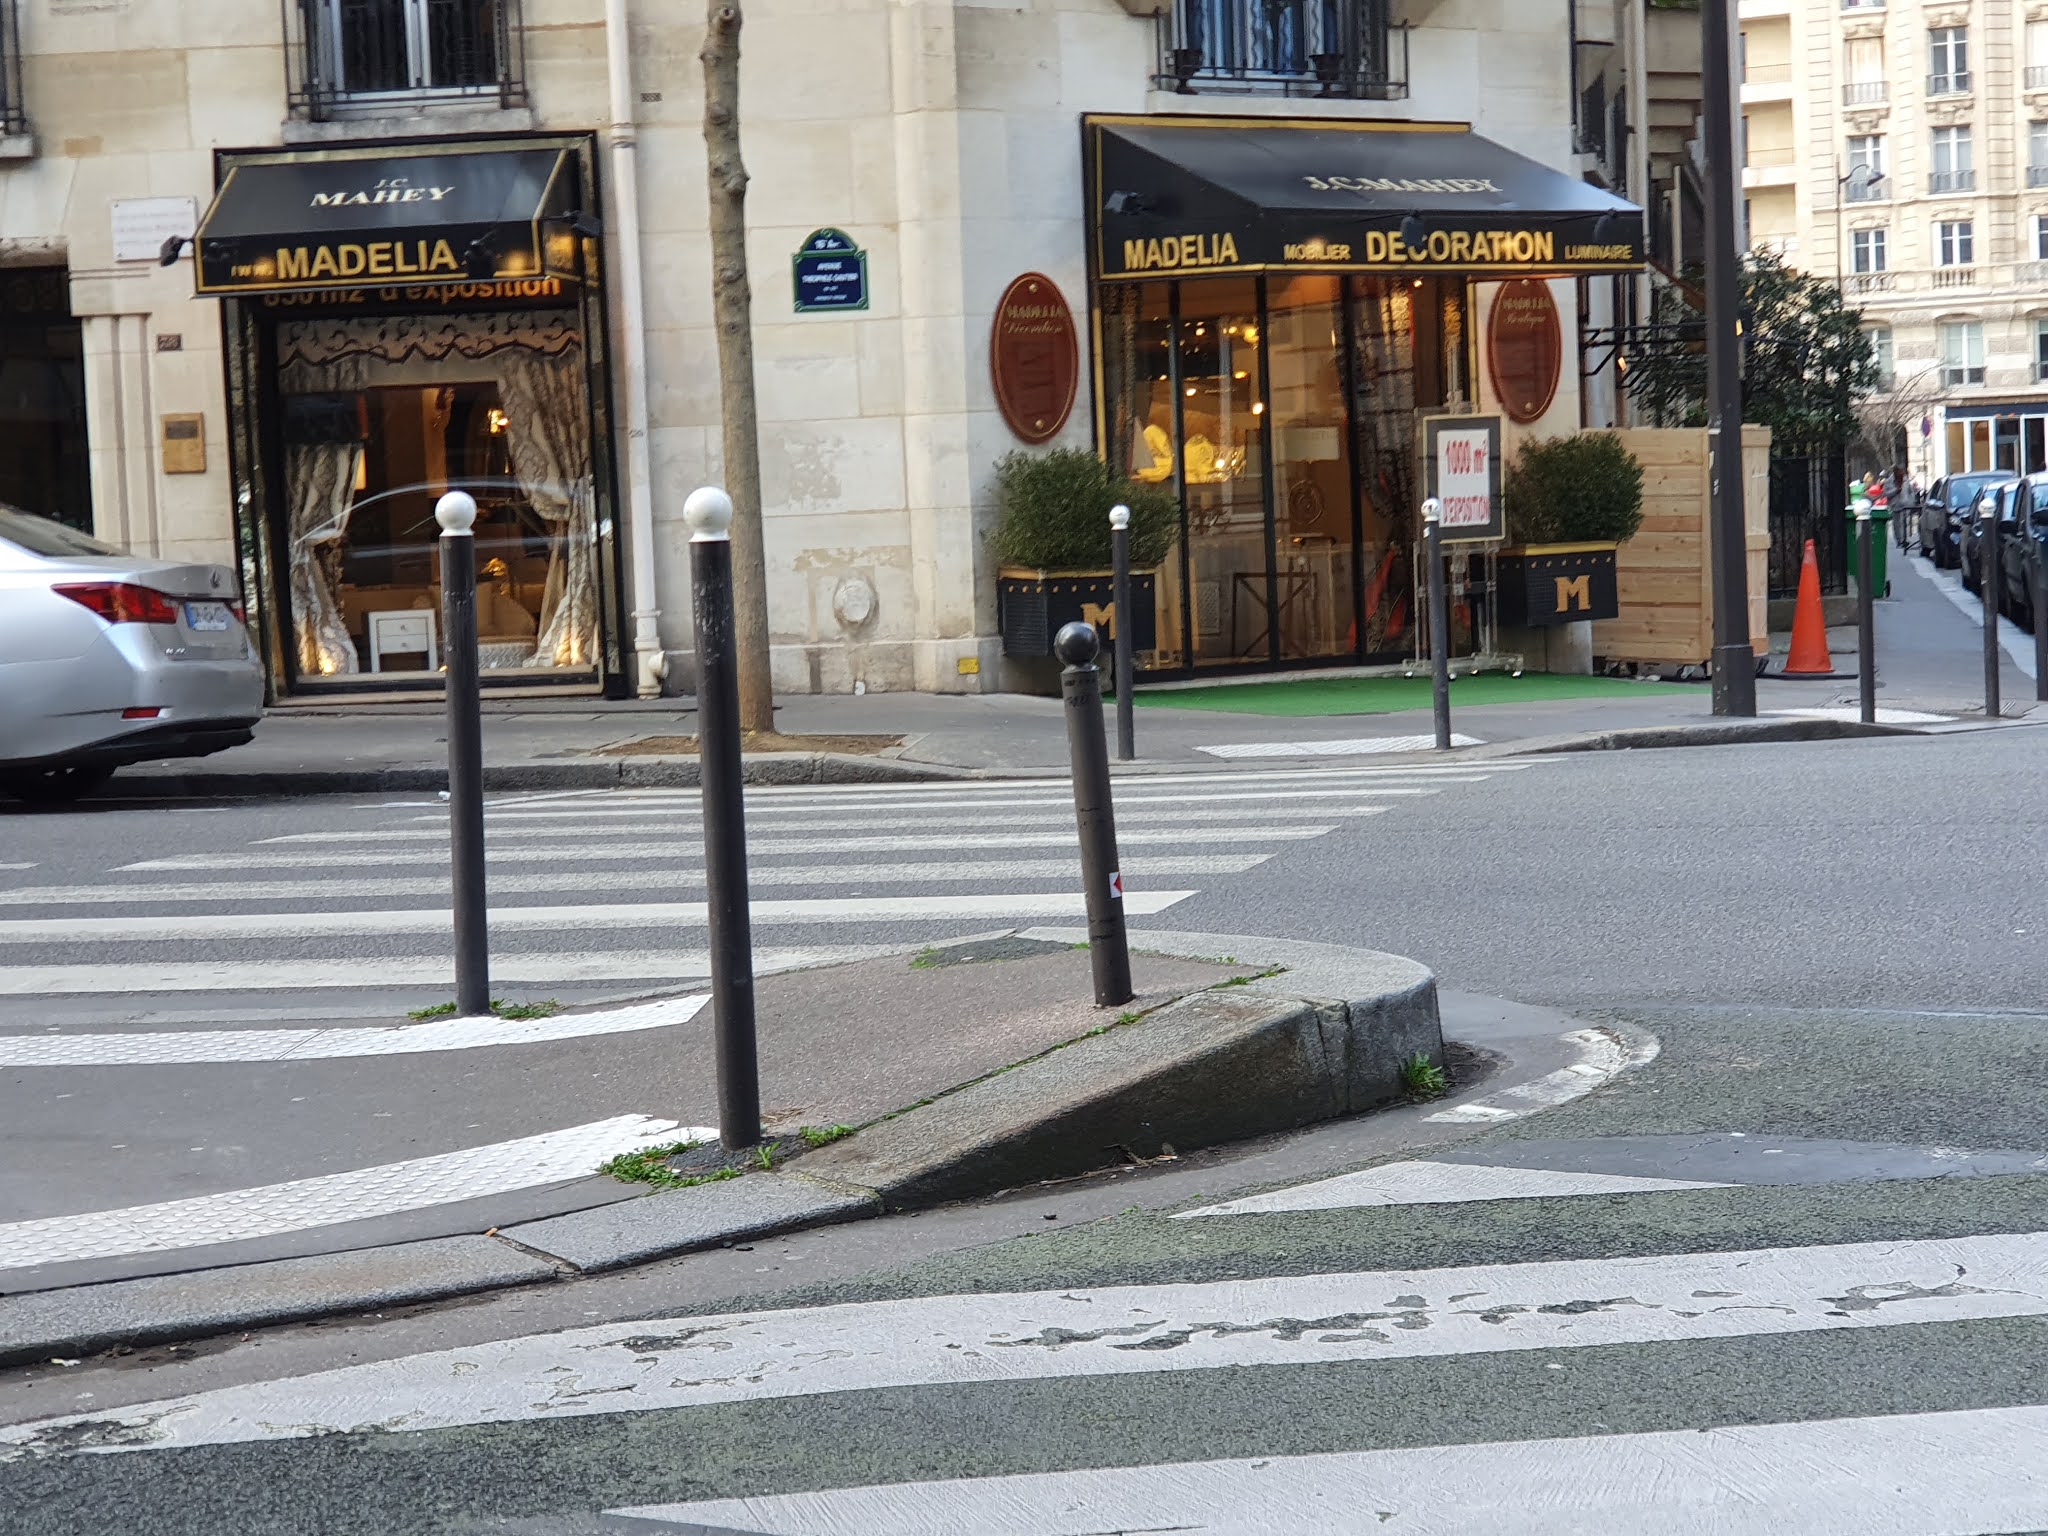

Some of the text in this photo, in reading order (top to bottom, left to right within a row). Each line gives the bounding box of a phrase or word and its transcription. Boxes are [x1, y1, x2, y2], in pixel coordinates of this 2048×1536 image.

[309, 187, 455, 207] MAHEY
[276, 239, 457, 280] MADELIA
[1124, 232, 1239, 270] MADELIA
[1284, 244, 1351, 261] MOBILIER
[1565, 244, 1633, 260] LUMINAIRE
[1554, 575, 1591, 613] M
